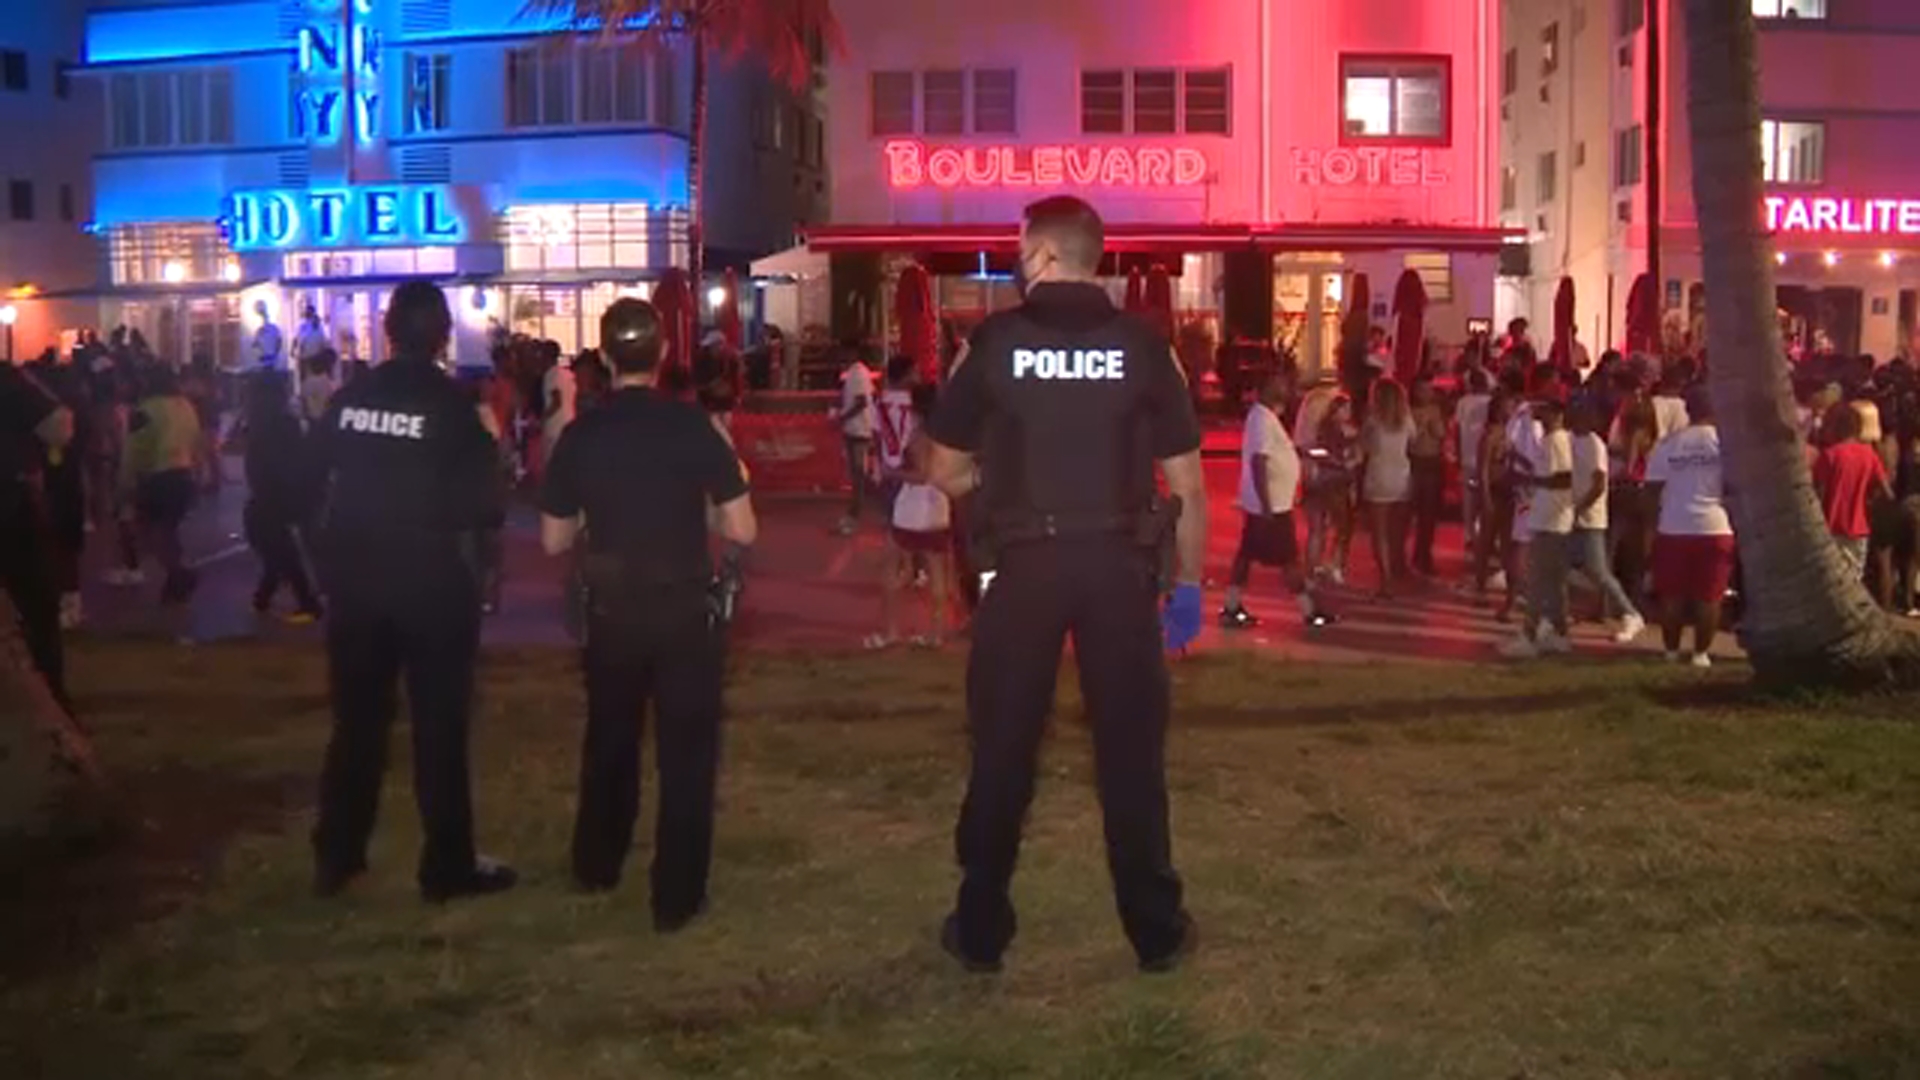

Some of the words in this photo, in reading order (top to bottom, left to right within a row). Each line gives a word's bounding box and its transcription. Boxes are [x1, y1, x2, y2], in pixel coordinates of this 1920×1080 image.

[298, 0, 342, 140] NY
[1291, 147, 1448, 185] HOTEL
[227, 190, 458, 246] HOTEL
[1013, 349, 1125, 379] POLICE
[339, 407, 425, 439] POLICE
